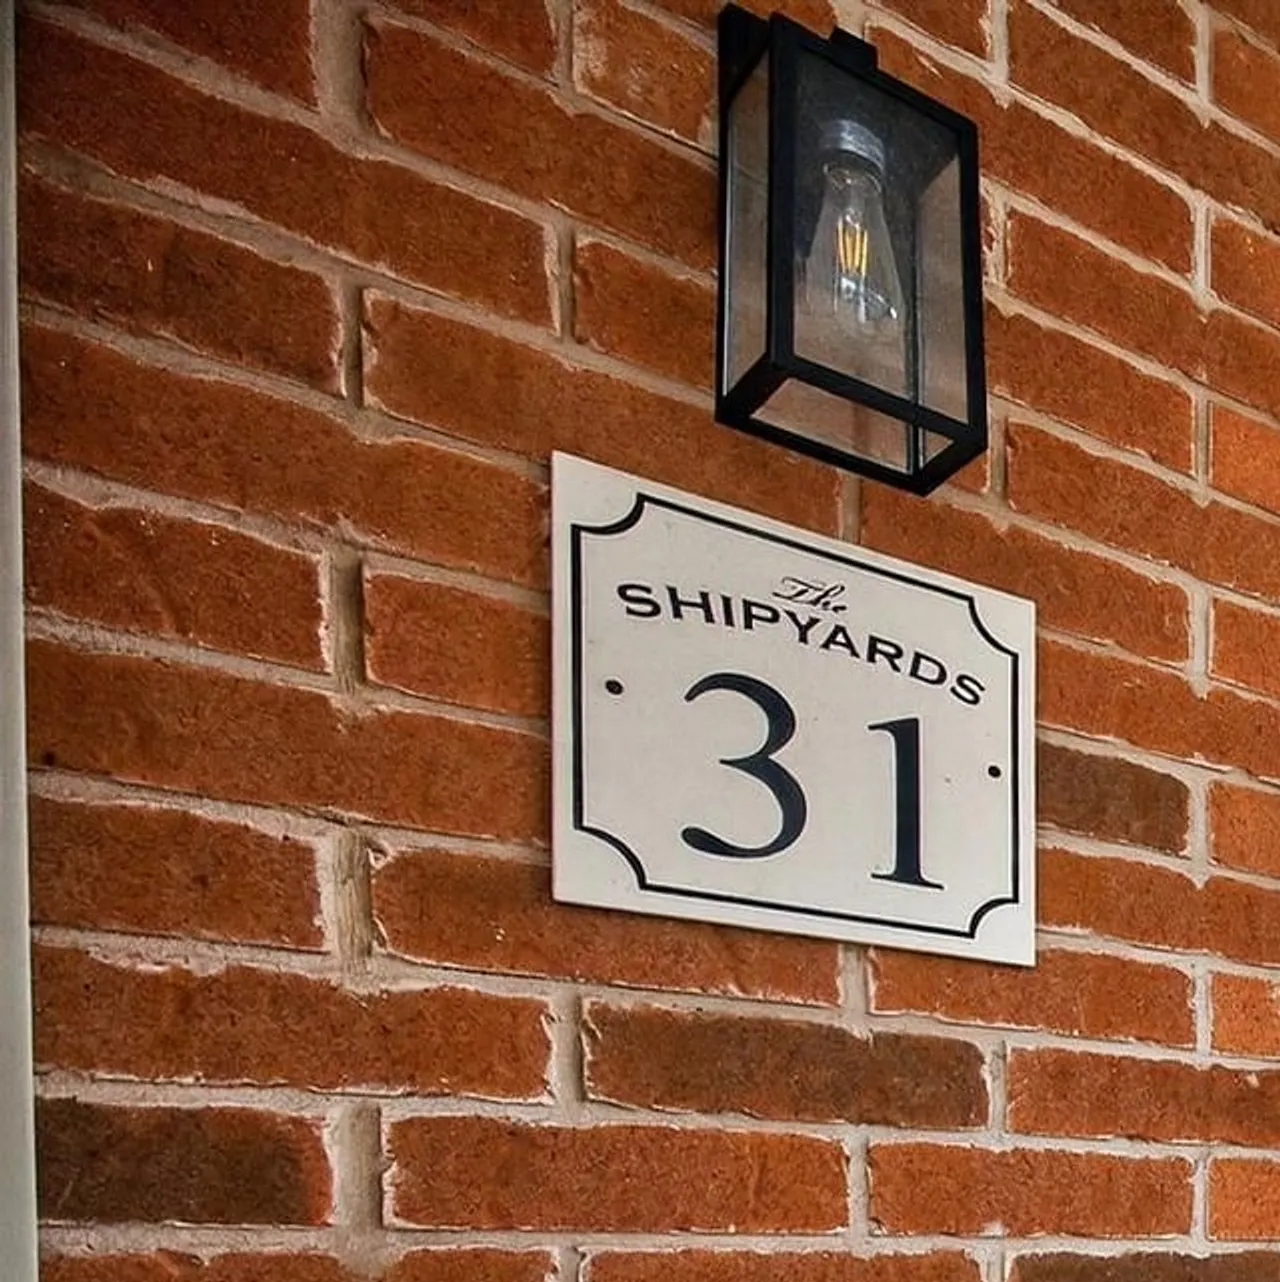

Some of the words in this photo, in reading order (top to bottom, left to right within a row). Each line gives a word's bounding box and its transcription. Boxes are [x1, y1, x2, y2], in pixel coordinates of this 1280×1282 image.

[616, 582, 986, 706] SHIPYARDS
[772, 576, 848, 613] The
[681, 672, 945, 891] 31
